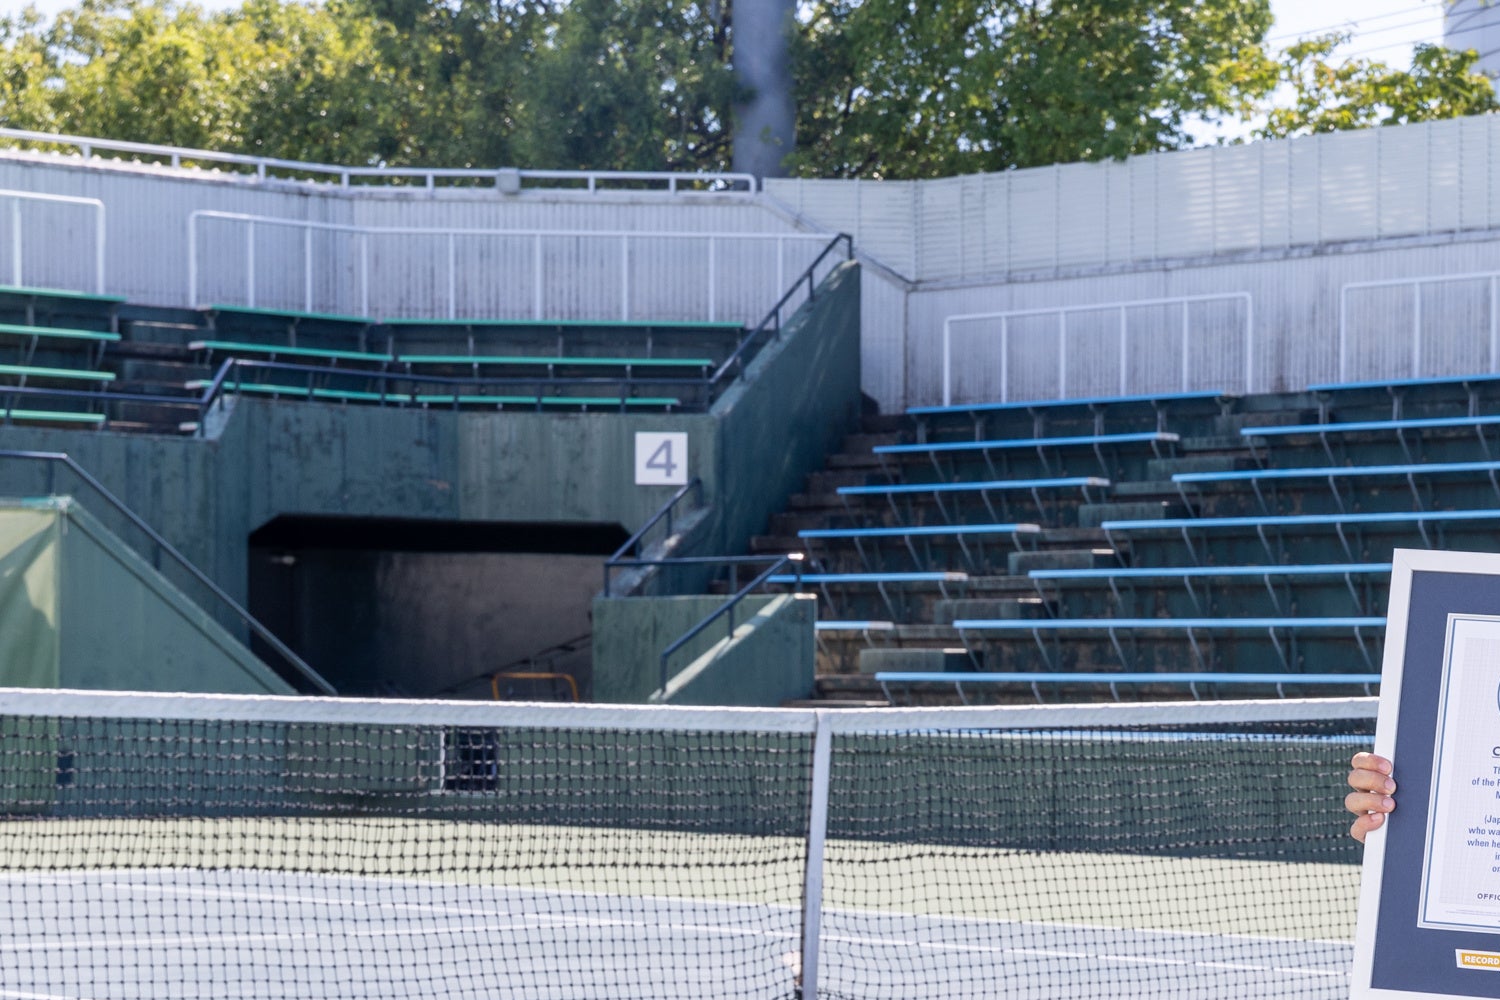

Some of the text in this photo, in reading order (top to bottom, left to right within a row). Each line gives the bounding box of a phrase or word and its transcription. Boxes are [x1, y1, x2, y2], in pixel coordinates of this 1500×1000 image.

[646, 440, 677, 477] 4
[1471, 777, 1480, 786] of
[1482, 778, 1495, 787] the
[1464, 955, 1500, 965] RECORD
